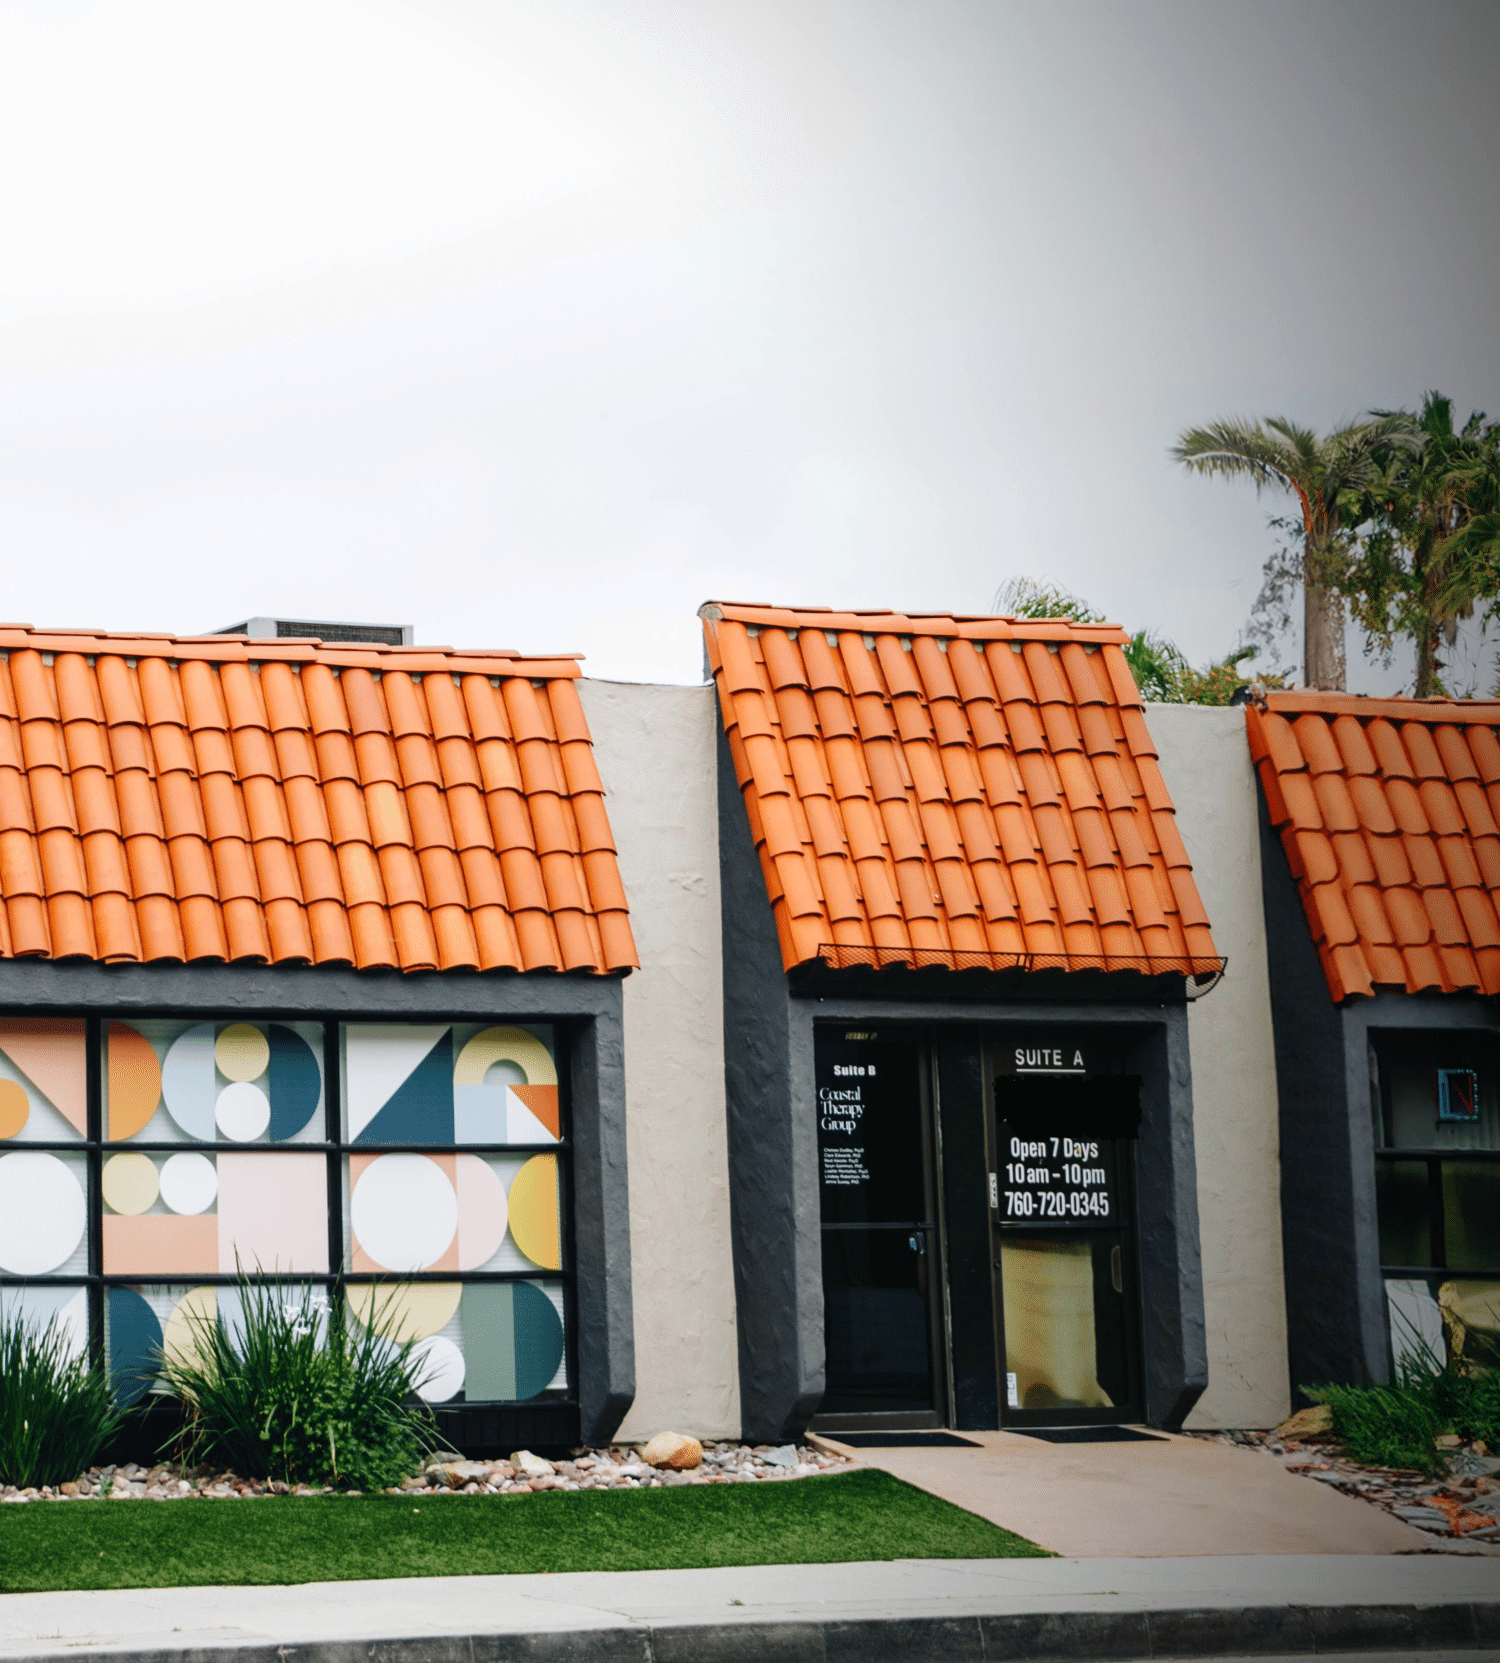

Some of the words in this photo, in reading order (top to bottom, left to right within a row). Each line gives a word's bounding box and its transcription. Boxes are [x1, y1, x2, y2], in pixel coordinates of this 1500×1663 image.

[1015, 1048, 1062, 1066] SUITE
[1073, 1050, 1084, 1066] A
[833, 1064, 866, 1076] Suite
[867, 1064, 876, 1076] B
[819, 1086, 861, 1101] Coastal
[820, 1100, 865, 1119] Therapy
[821, 1116, 857, 1135] Group
[1010, 1136, 1047, 1162] Open
[1050, 1137, 1060, 1158] 7
[1063, 1138, 1099, 1162] Days
[1004, 1191, 1109, 1217] 760-720-0345
